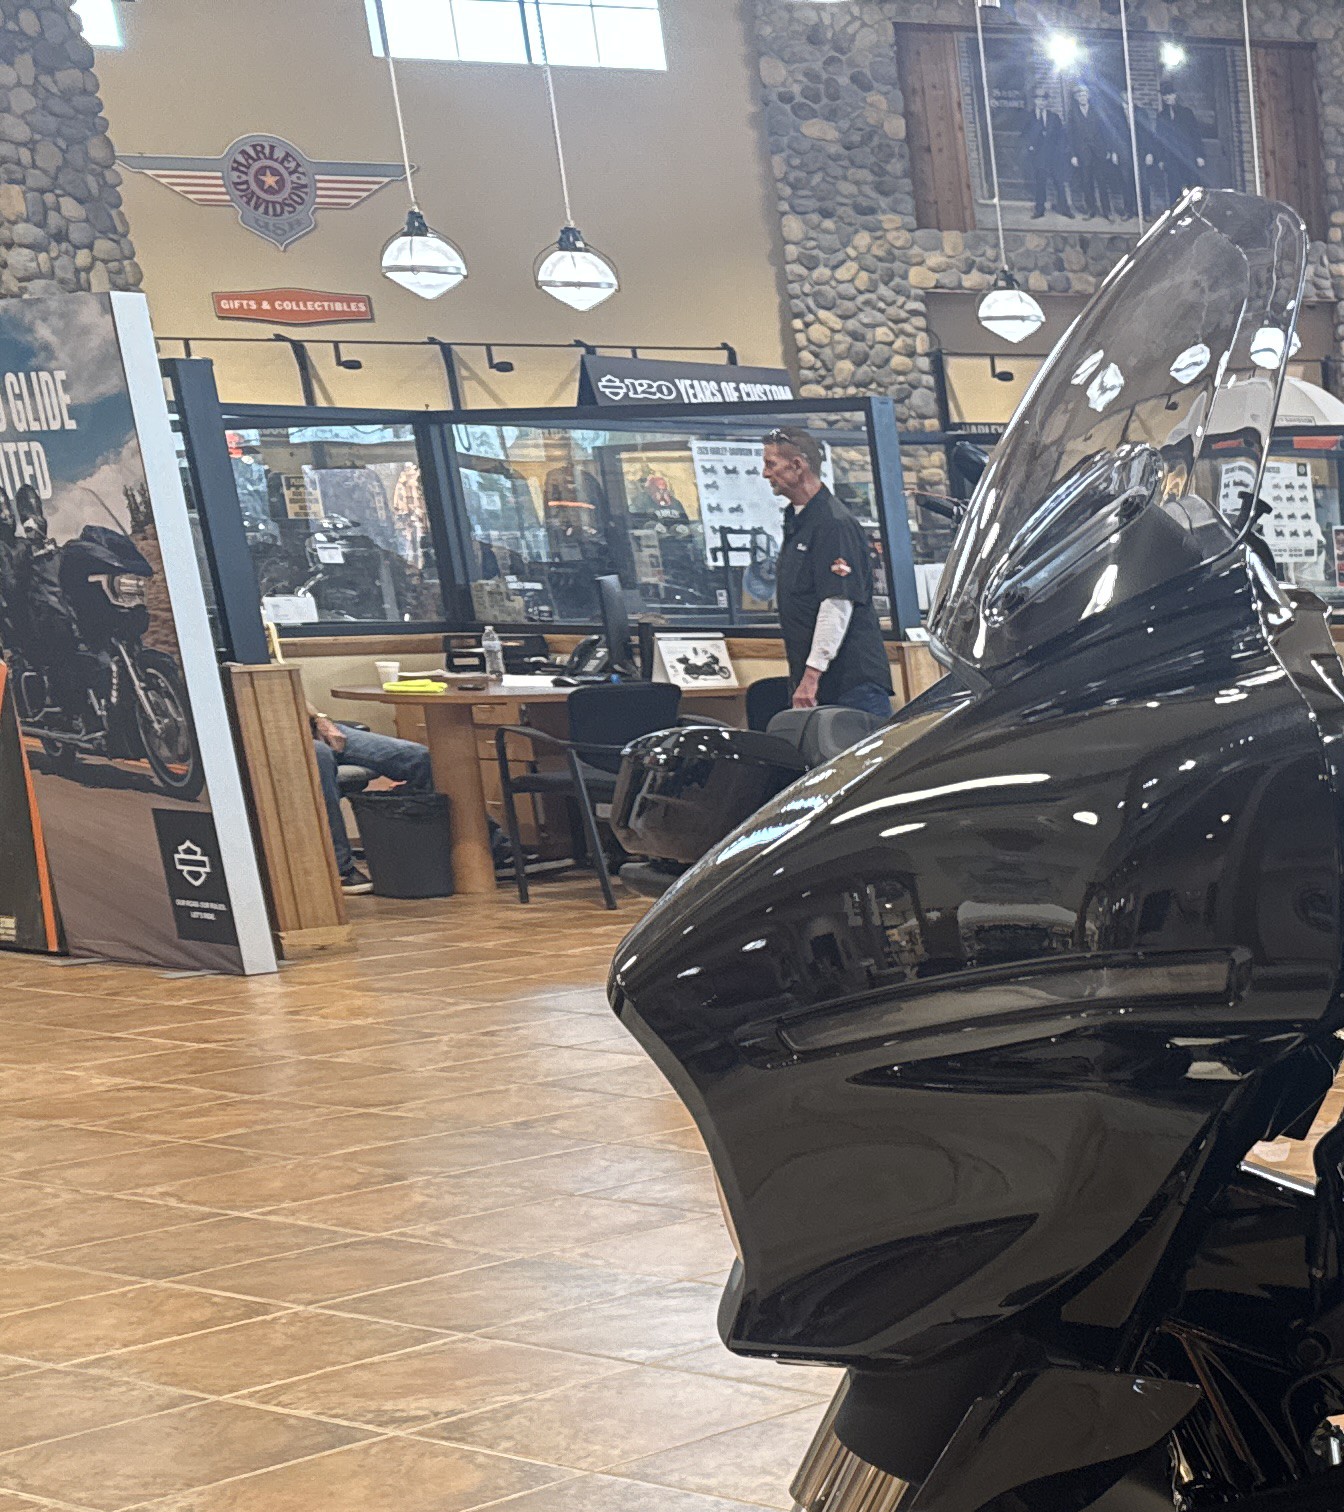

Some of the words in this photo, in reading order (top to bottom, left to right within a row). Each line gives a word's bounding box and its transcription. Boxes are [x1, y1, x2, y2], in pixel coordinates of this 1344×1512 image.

[231, 143, 306, 178] HARLEY
[231, 179, 309, 217] DAVIDSON
[220, 299, 257, 310] GIFTS
[261, 300, 271, 310] &
[275, 300, 367, 312] COLLECTIBLES
[4, 370, 77, 433] GLIDE
[624, 378, 676, 399] 120
[675, 379, 723, 403] YEARS
[722, 381, 739, 402] OF
[739, 383, 794, 402] CUSTOM
